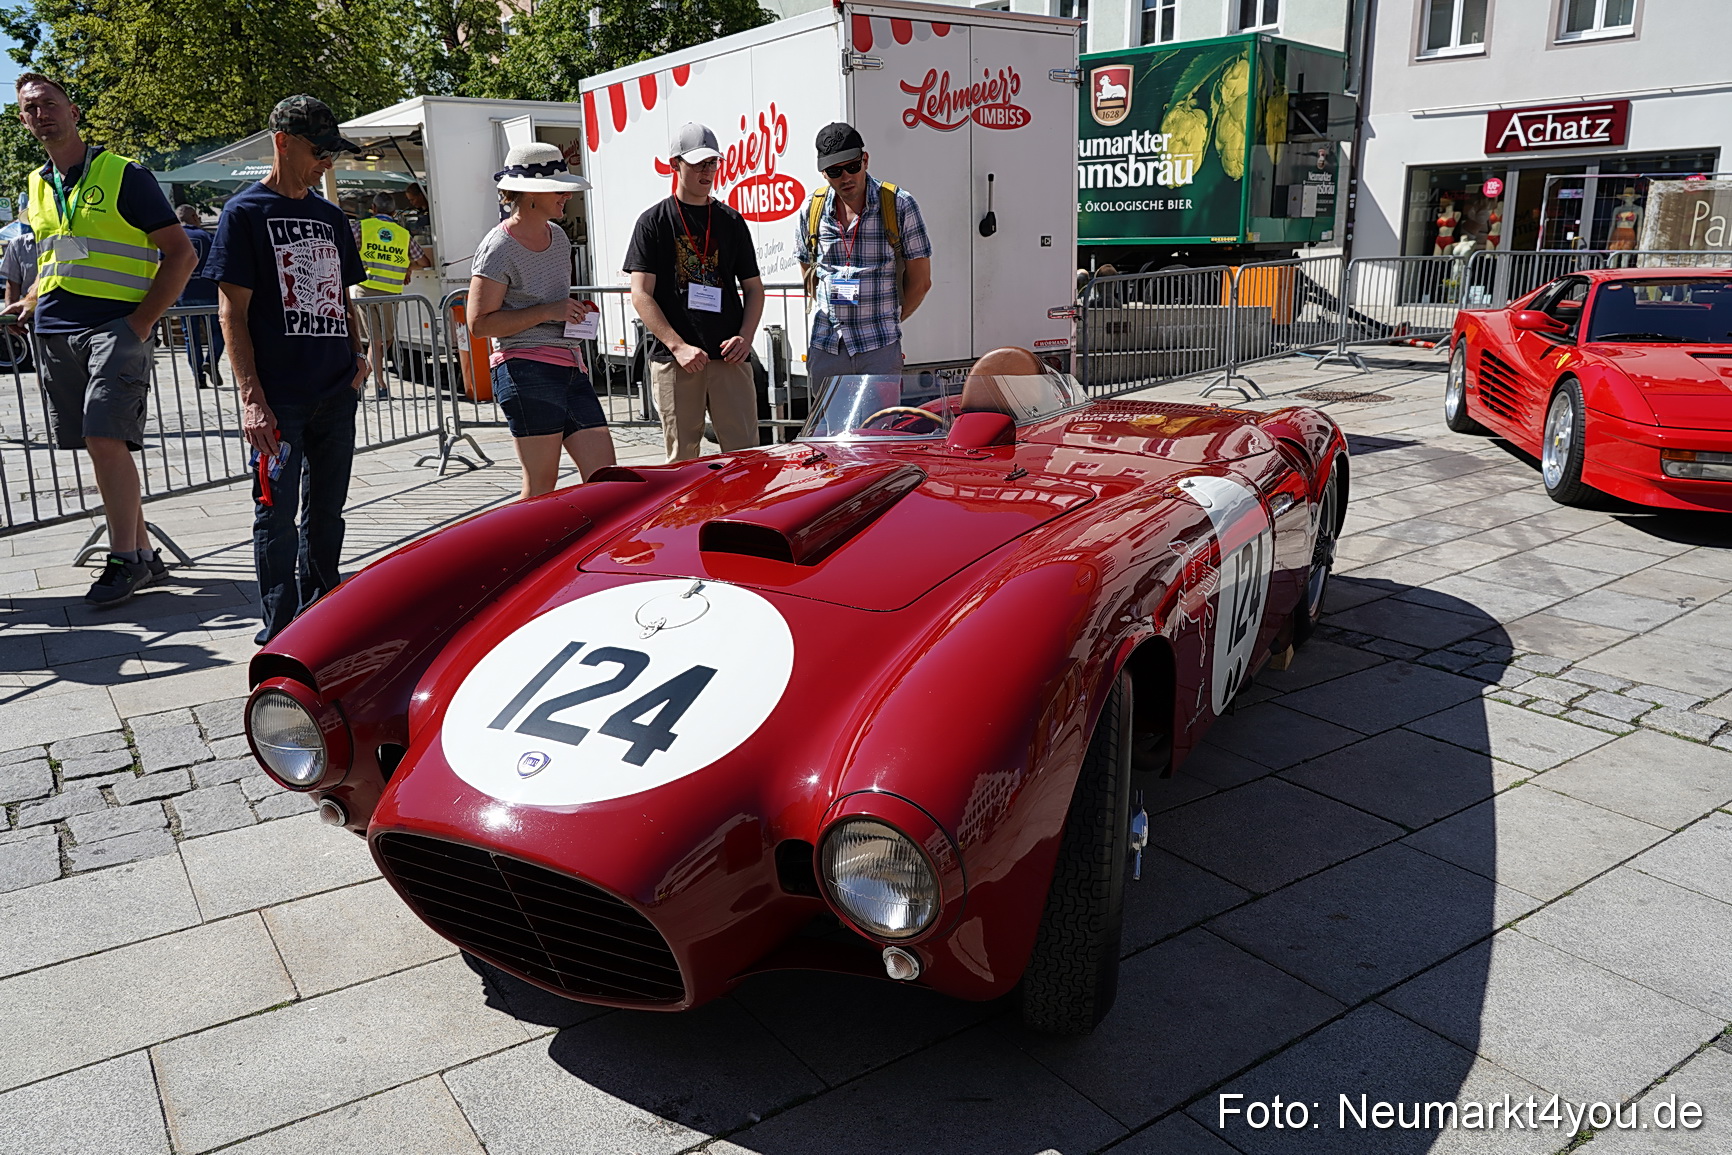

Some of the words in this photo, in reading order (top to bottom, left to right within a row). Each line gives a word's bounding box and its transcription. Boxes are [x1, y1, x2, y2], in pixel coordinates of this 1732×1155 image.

[899, 65, 1022, 131] Lehmeier's
[979, 107, 1024, 125] IMBISS
[1101, 110, 1120, 119] 1628
[1077, 129, 1172, 157] umarkter
[1496, 111, 1612, 149] Achatz
[736, 181, 795, 215] IMBISS
[1085, 200, 1165, 213] ÖKOLOGISCHE
[1167, 199, 1193, 210] BIER
[268, 219, 335, 246] OCEAN
[1688, 200, 1732, 248] Pa
[366, 243, 404, 255] FOLLOW
[377, 252, 392, 262] ME
[764, 238, 784, 259] Jahren
[285, 309, 347, 335] PACIFIC
[1226, 530, 1263, 656] 124
[486, 641, 718, 767] 124
